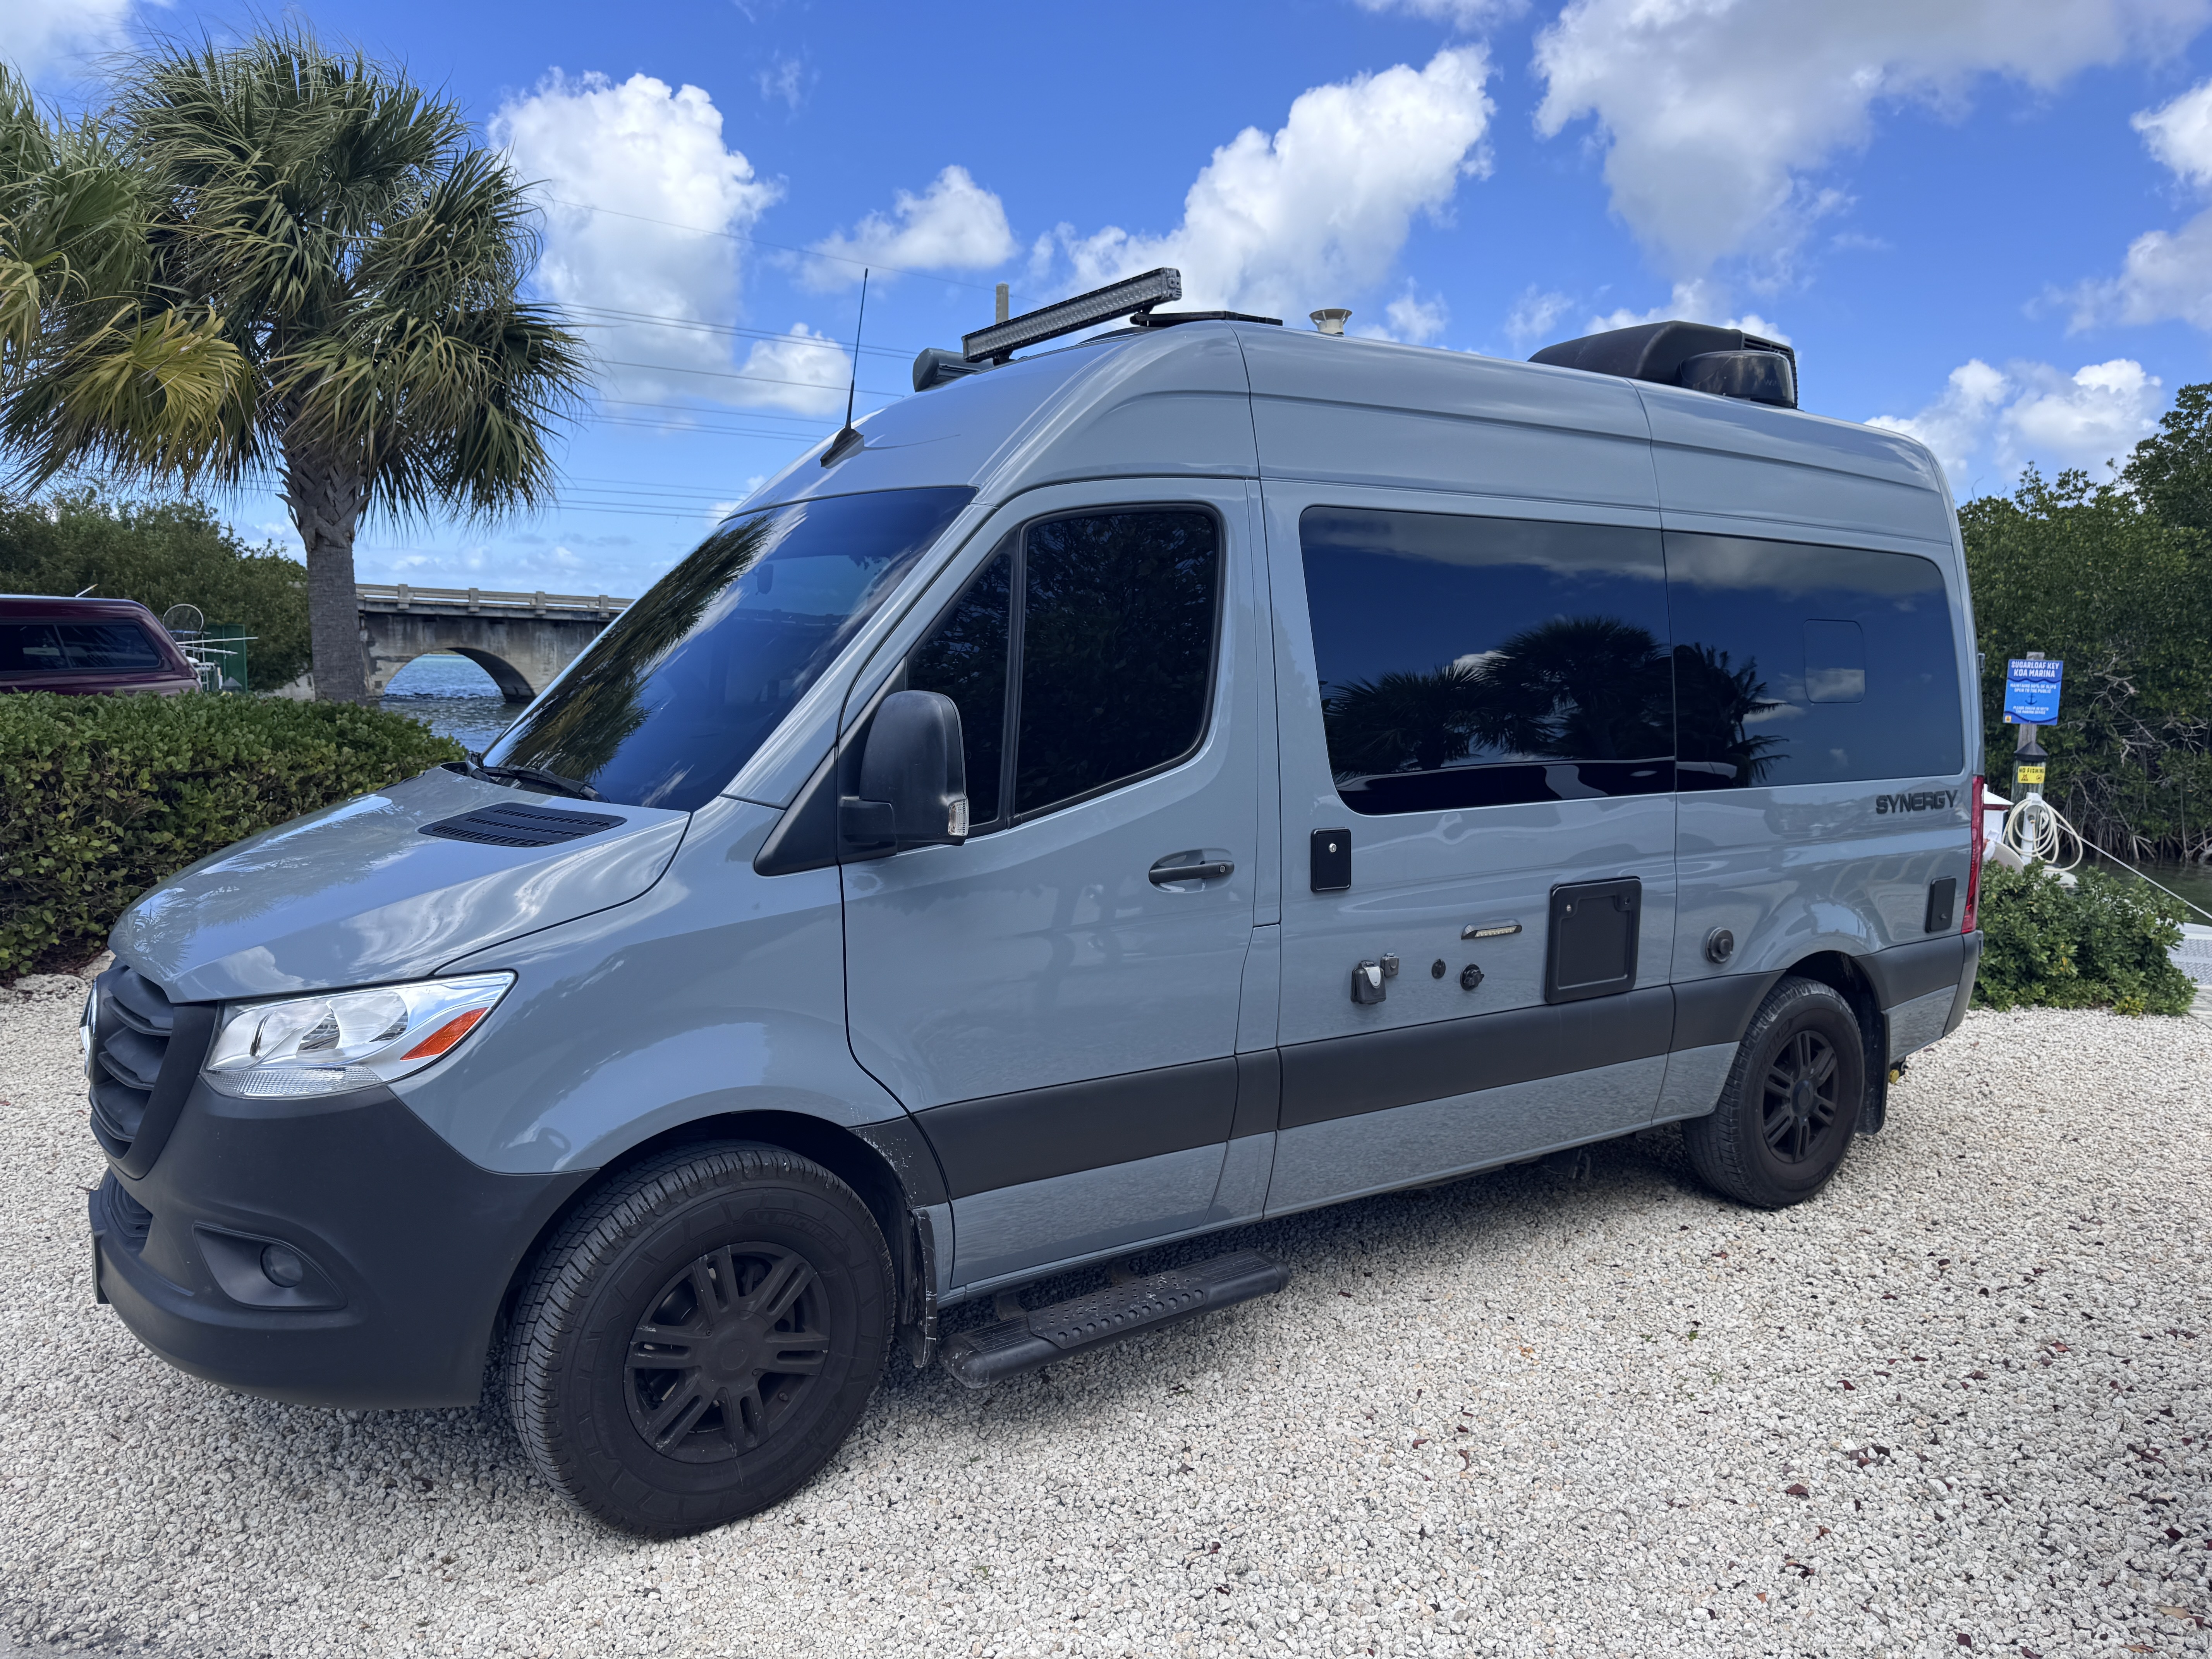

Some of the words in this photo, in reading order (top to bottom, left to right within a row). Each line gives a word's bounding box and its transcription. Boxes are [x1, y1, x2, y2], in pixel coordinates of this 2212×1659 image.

[2011, 661, 2047, 669] SUGARLOAF
[2014, 668, 2028, 677] KOA
[2029, 669, 2055, 678] MARINA
[1876, 790, 1958, 814] SYNERGY
[771, 1213, 844, 1254] MICHELIN
